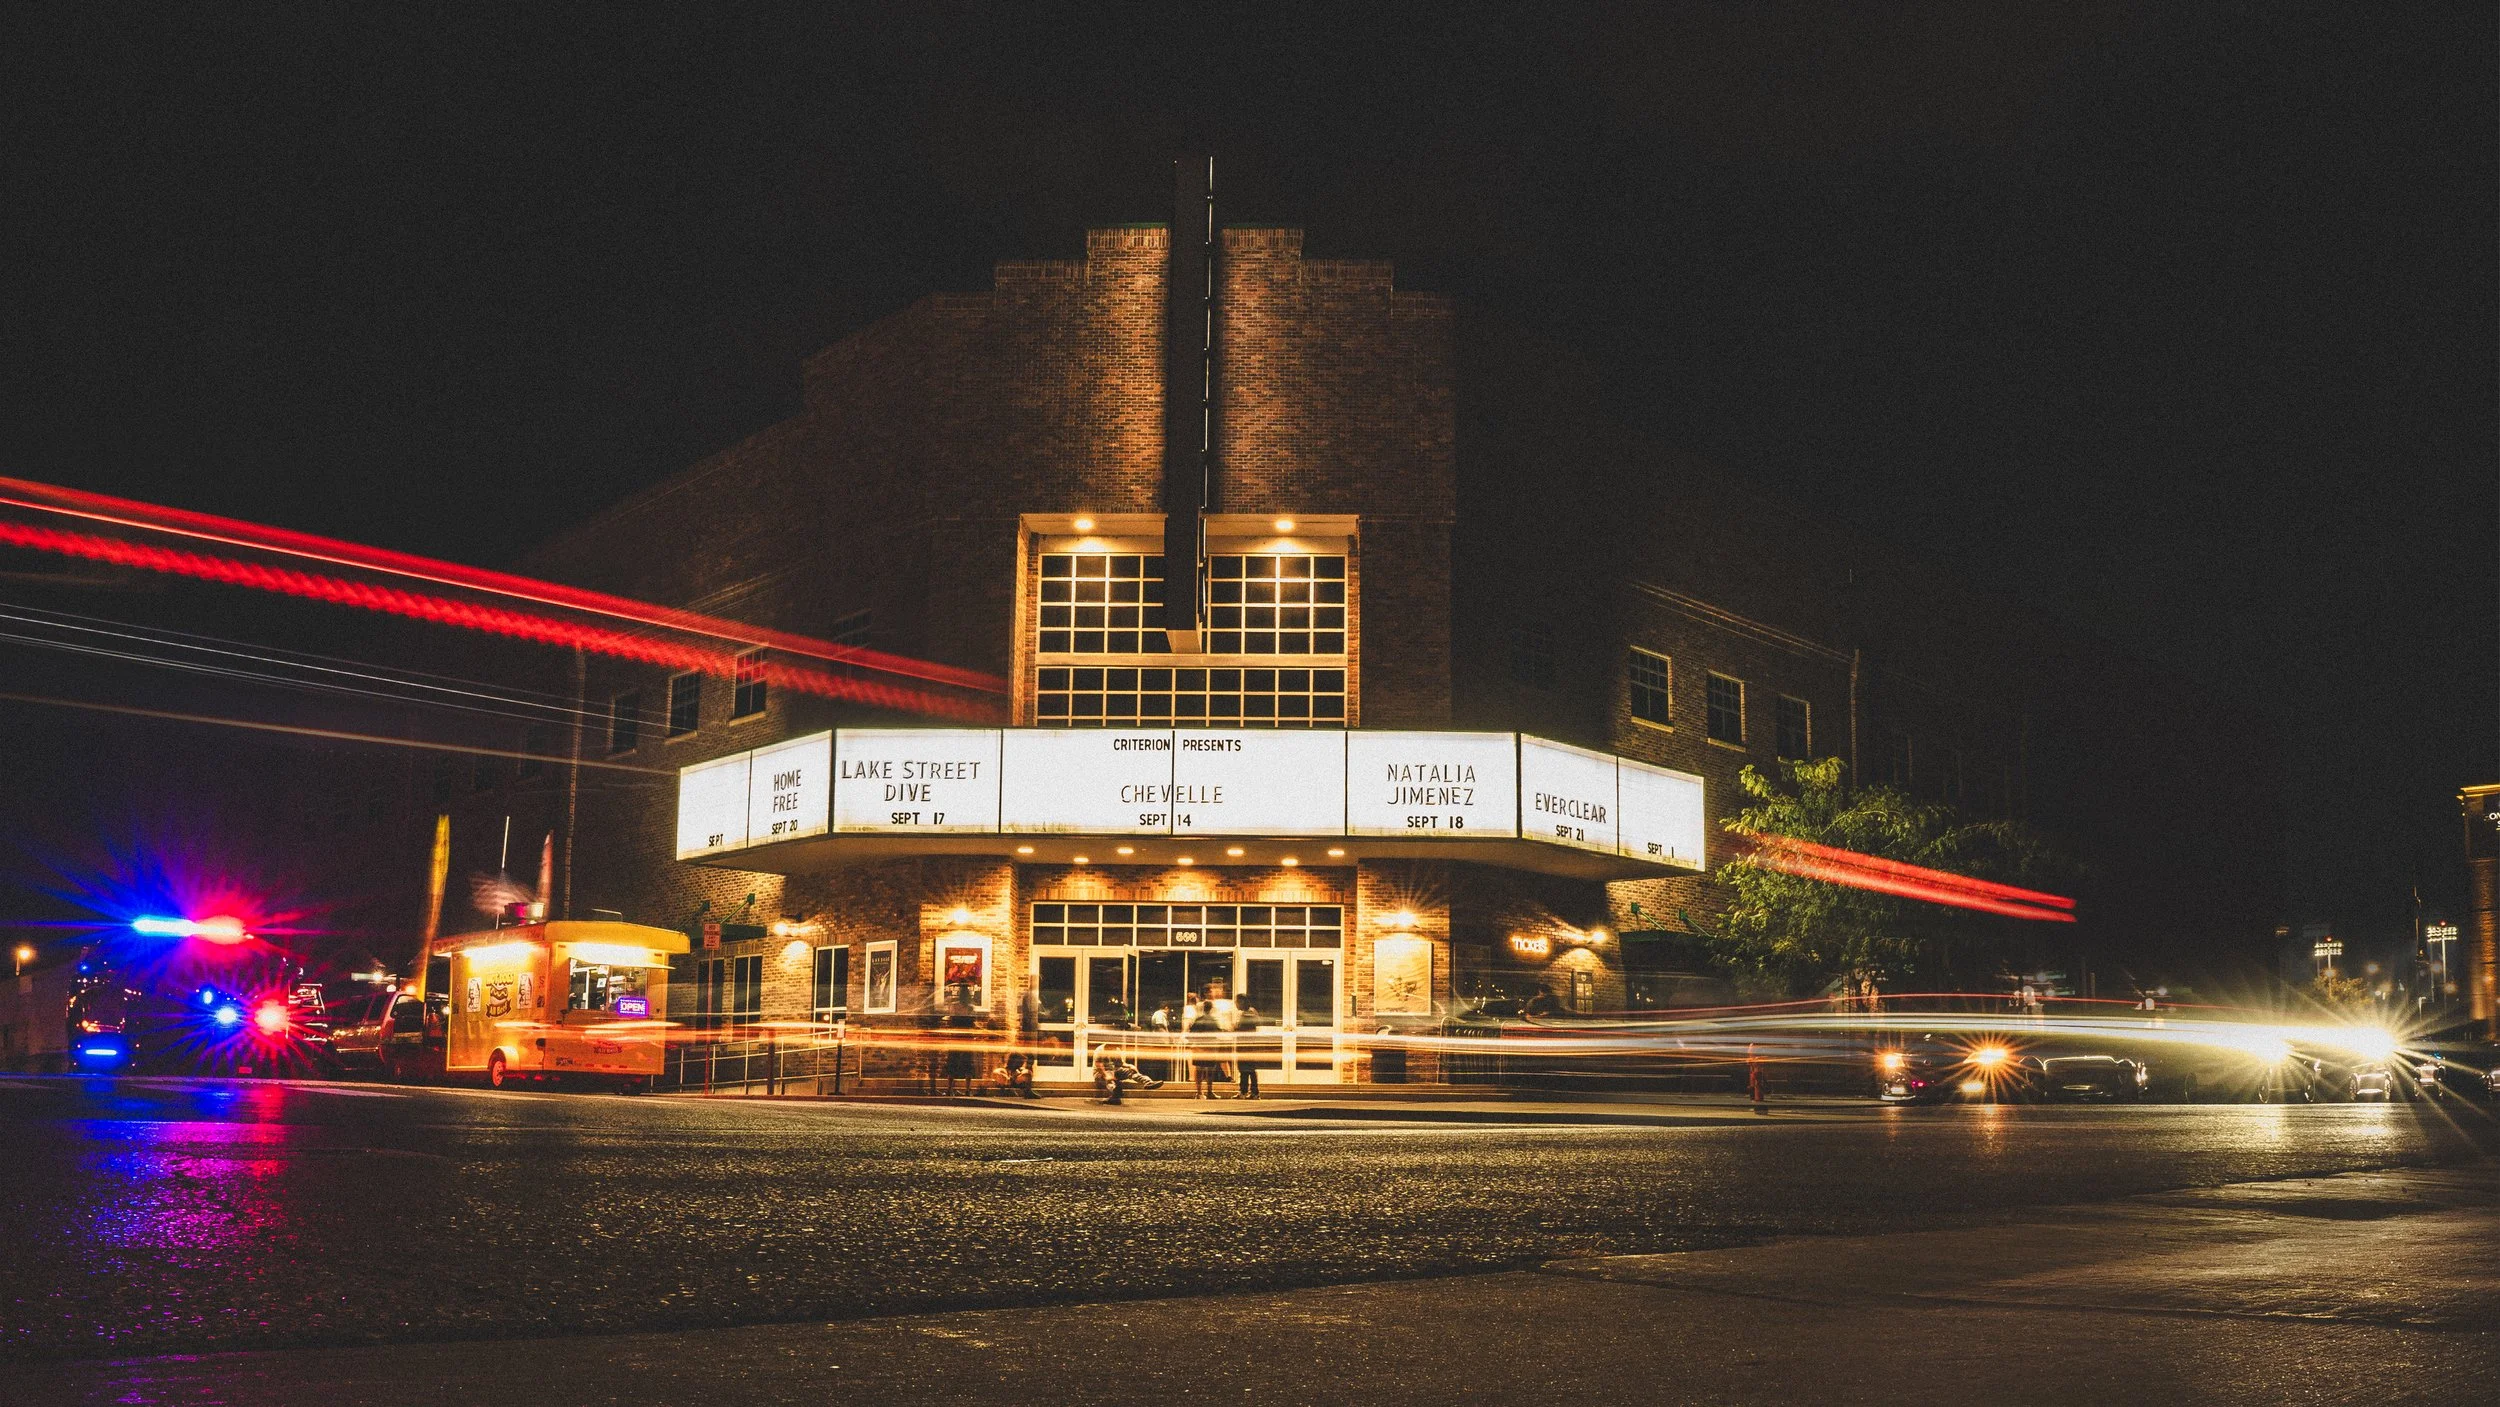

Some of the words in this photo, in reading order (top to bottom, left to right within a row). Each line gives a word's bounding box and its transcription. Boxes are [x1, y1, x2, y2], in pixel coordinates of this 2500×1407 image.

[1113, 738, 1171, 751] CRITERION
[1182, 739, 1242, 752] PRESENTS
[841, 760, 893, 779] LAKE
[902, 760, 981, 780] STREET
[1387, 764, 1476, 783] NATALIA
[773, 769, 802, 792] HOME
[884, 783, 932, 802] DIVE
[1120, 784, 1224, 804] CHEVELLE
[1387, 786, 1475, 806] JIMENEZ
[772, 792, 798, 813] FREE
[1535, 792, 1607, 824] EVERCLEAR
[771, 820, 788, 835] SEPT
[789, 819, 798, 832] 20
[891, 812, 921, 825] SEPT
[933, 812, 946, 825] 17
[1139, 813, 1167, 826] SEPT
[1177, 814, 1192, 827] 14
[1407, 815, 1439, 829] SEPT
[1449, 815, 1464, 829] 18
[708, 833, 724, 847] SEPT
[1555, 824, 1573, 840] SEPT
[1576, 827, 1585, 842] 21
[1647, 841, 1663, 856] SEPT
[621, 1002, 644, 1012] OPEN
